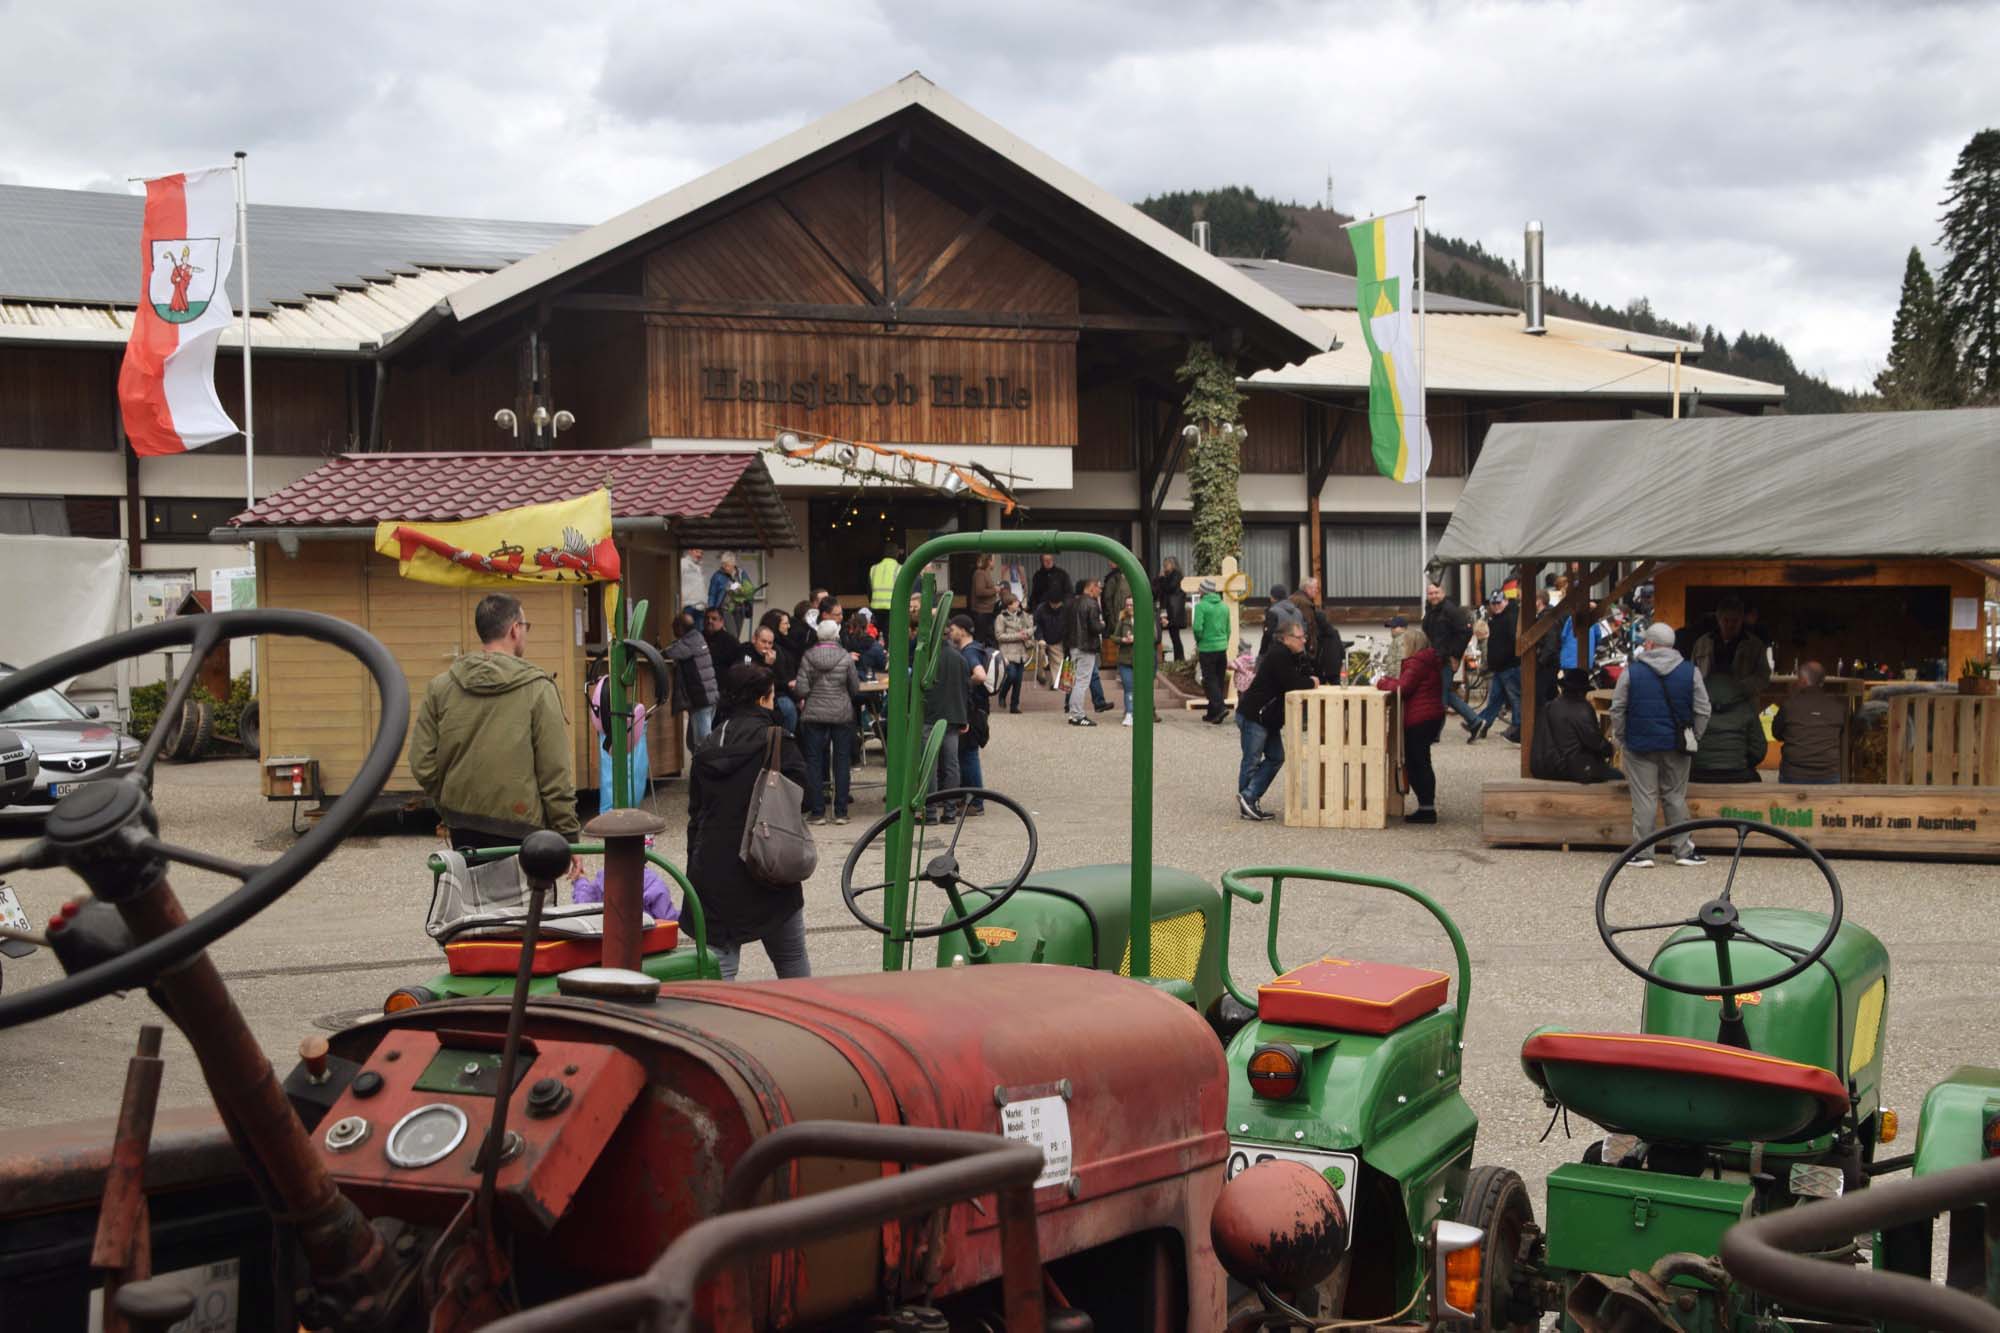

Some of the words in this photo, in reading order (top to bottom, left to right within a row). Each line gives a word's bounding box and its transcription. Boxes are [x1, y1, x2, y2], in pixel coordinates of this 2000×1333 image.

[702, 367, 919, 410] Hansjakob
[930, 373, 1032, 409] Halle
[1768, 807, 1814, 828] Wald
[1821, 813, 1848, 828] kein
[1852, 814, 1882, 828] Platz
[1887, 816, 1912, 828] zum
[1916, 816, 1977, 831] Ausruhen
